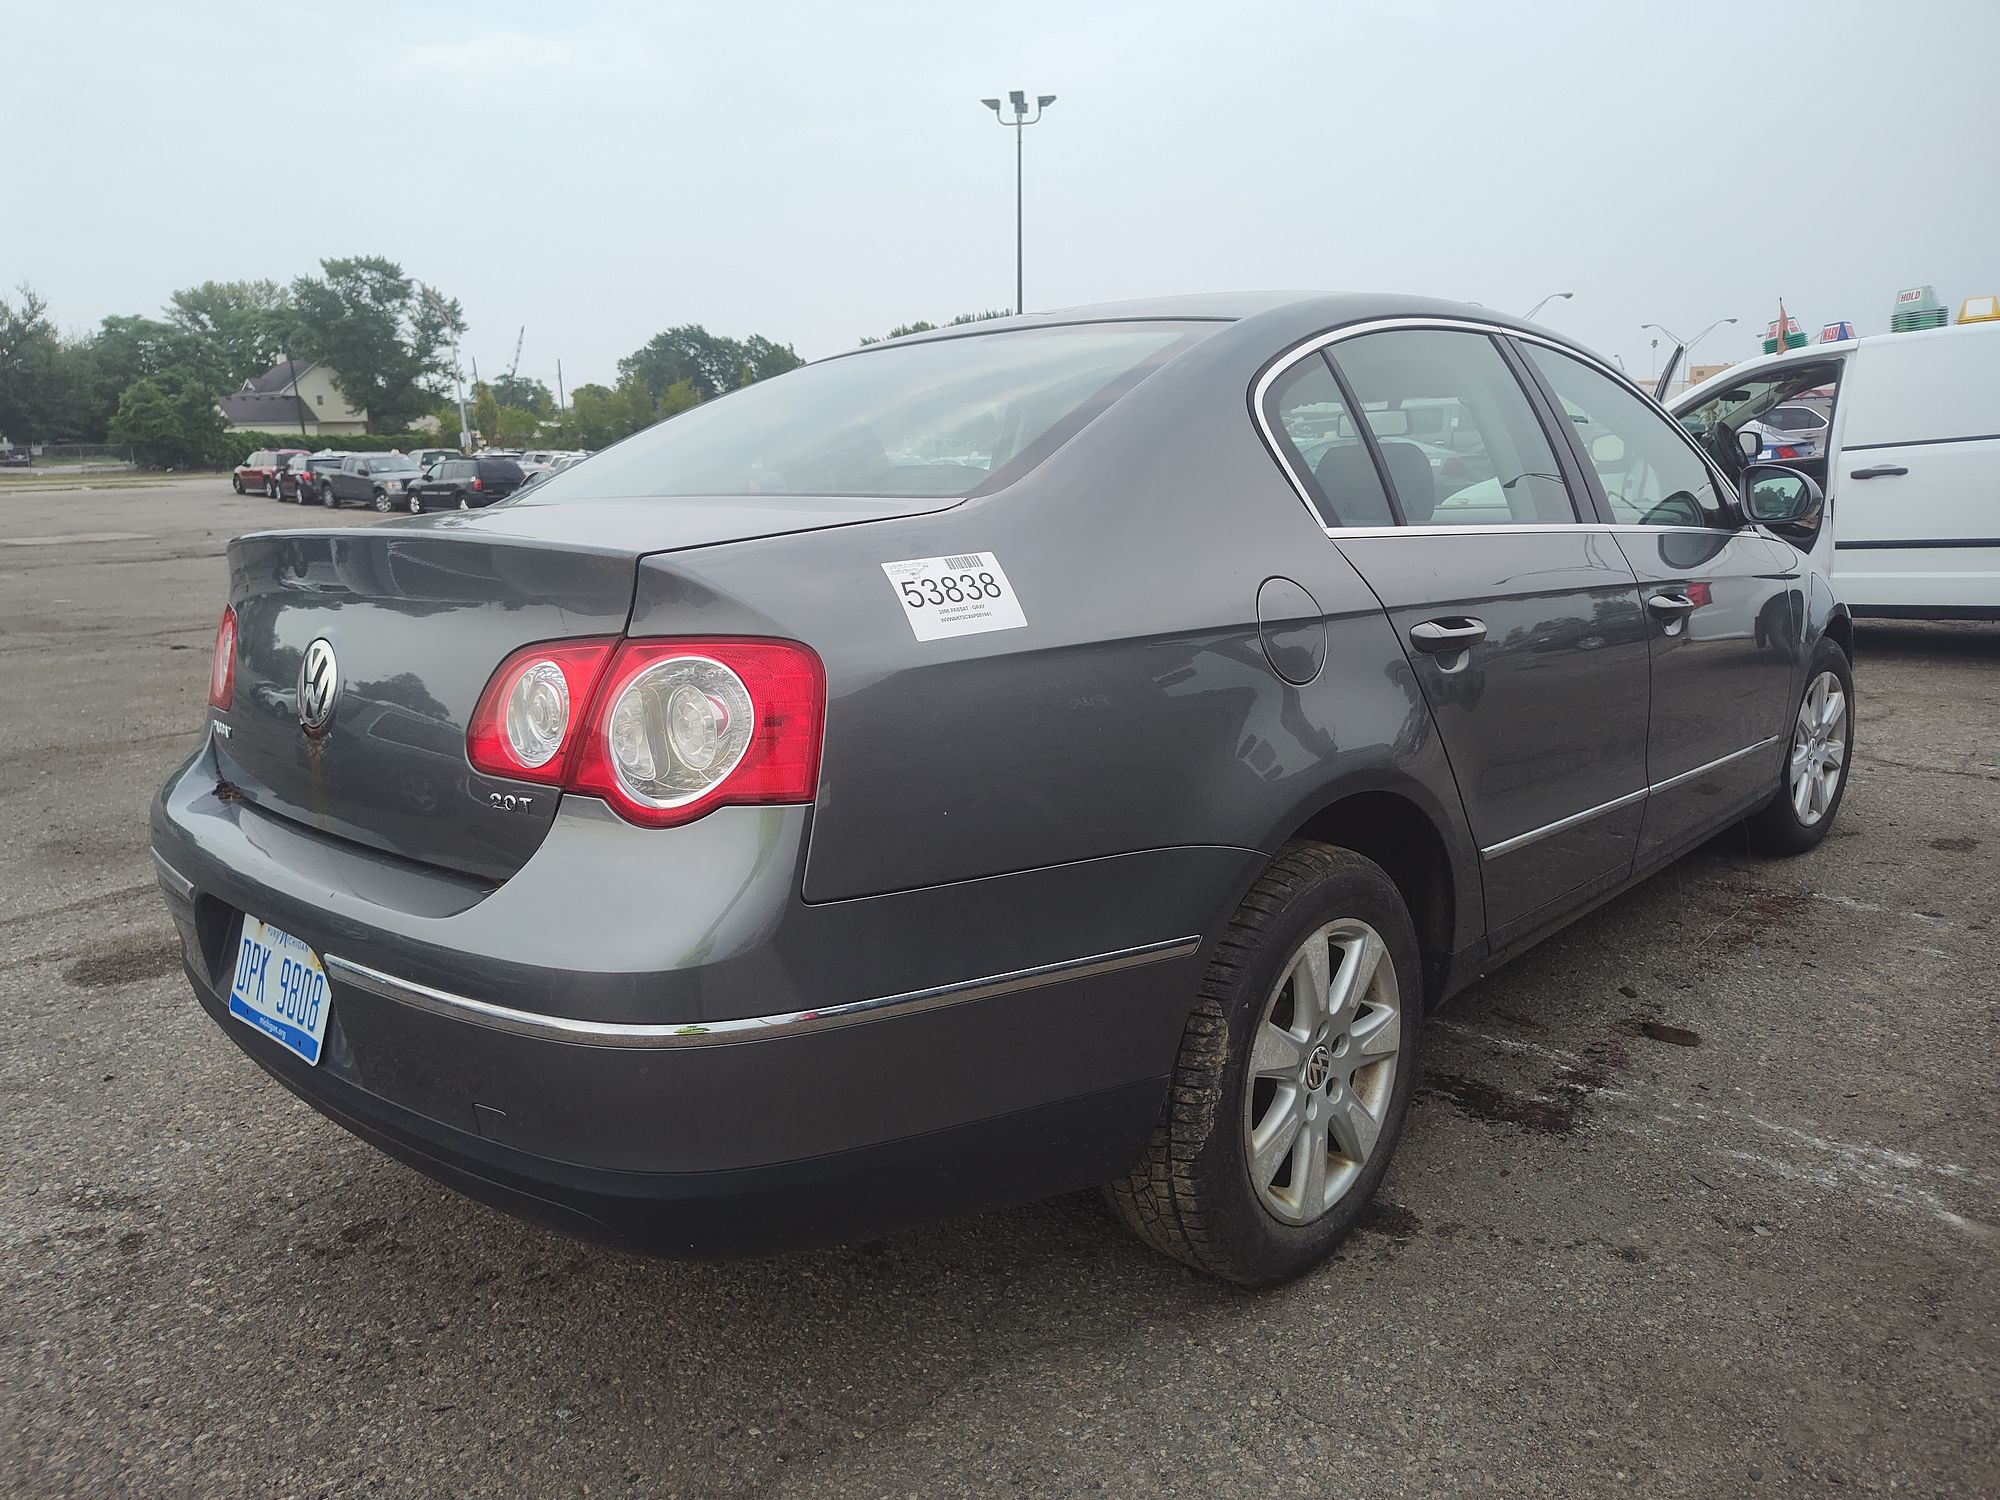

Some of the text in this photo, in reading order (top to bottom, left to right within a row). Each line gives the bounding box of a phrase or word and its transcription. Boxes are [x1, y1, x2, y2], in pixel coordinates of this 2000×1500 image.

[900, 572, 1002, 608] 53838
[236, 938, 324, 1033] DPK 9808
